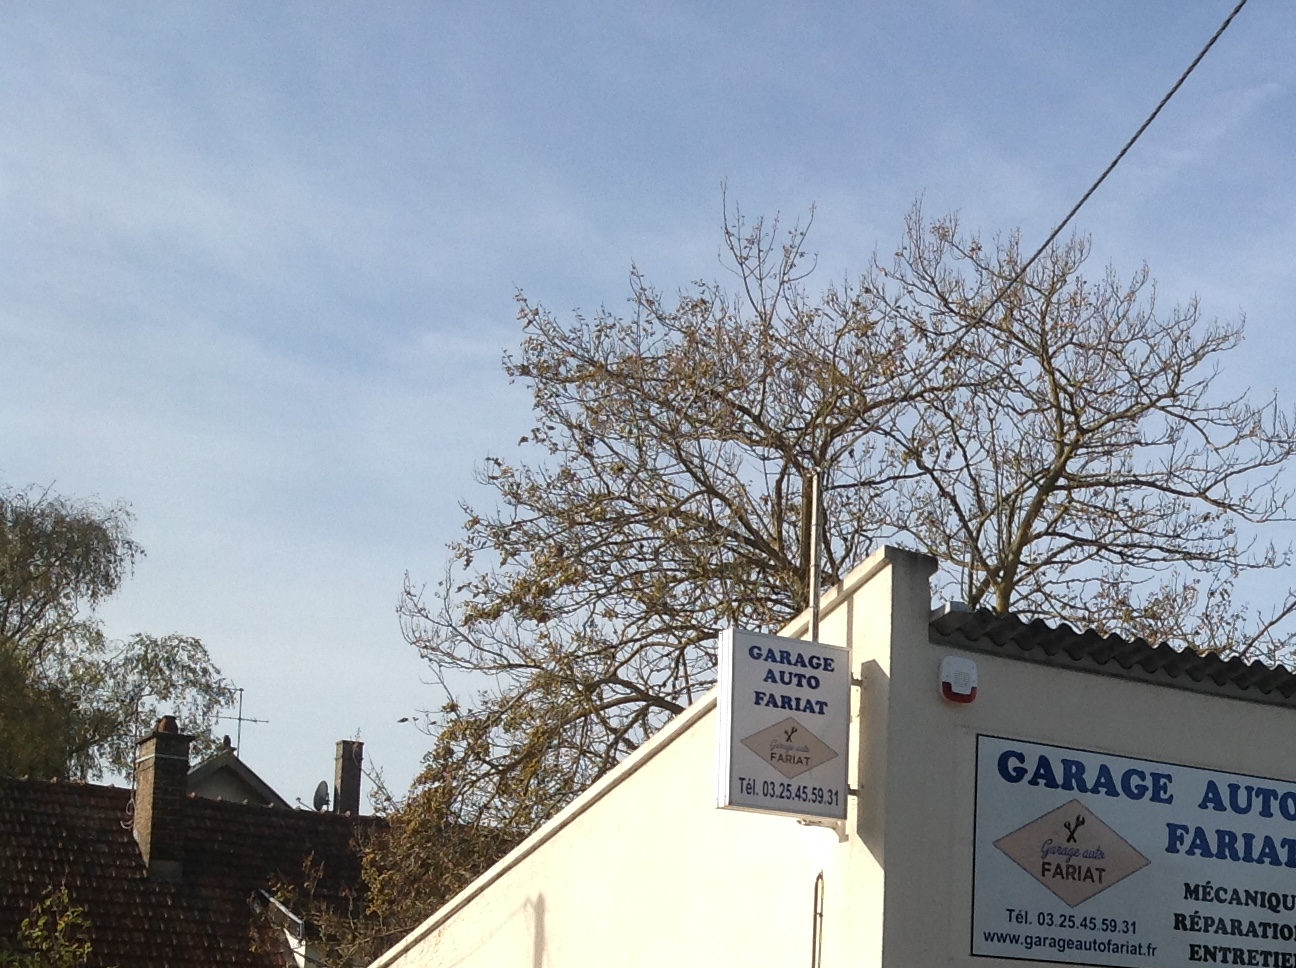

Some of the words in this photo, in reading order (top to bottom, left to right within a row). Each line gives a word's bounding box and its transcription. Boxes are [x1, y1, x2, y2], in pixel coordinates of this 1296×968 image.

[748, 645, 835, 673] GARAGE
[762, 668, 821, 690] AUTO
[753, 690, 828, 716] FARIAT
[770, 752, 811, 767] FARIAT
[997, 749, 1174, 805] GARAGE
[738, 776, 759, 797] Tél.
[762, 780, 840, 807] 03.25.45.59.31
[1040, 838, 1081, 863] Garage
[1041, 861, 1107, 884] FARIAT
[1005, 907, 1033, 926] Tél.
[1036, 911, 1138, 935] 03.25.45.59.31
[982, 930, 1158, 958] www.garageautofariat.fr
